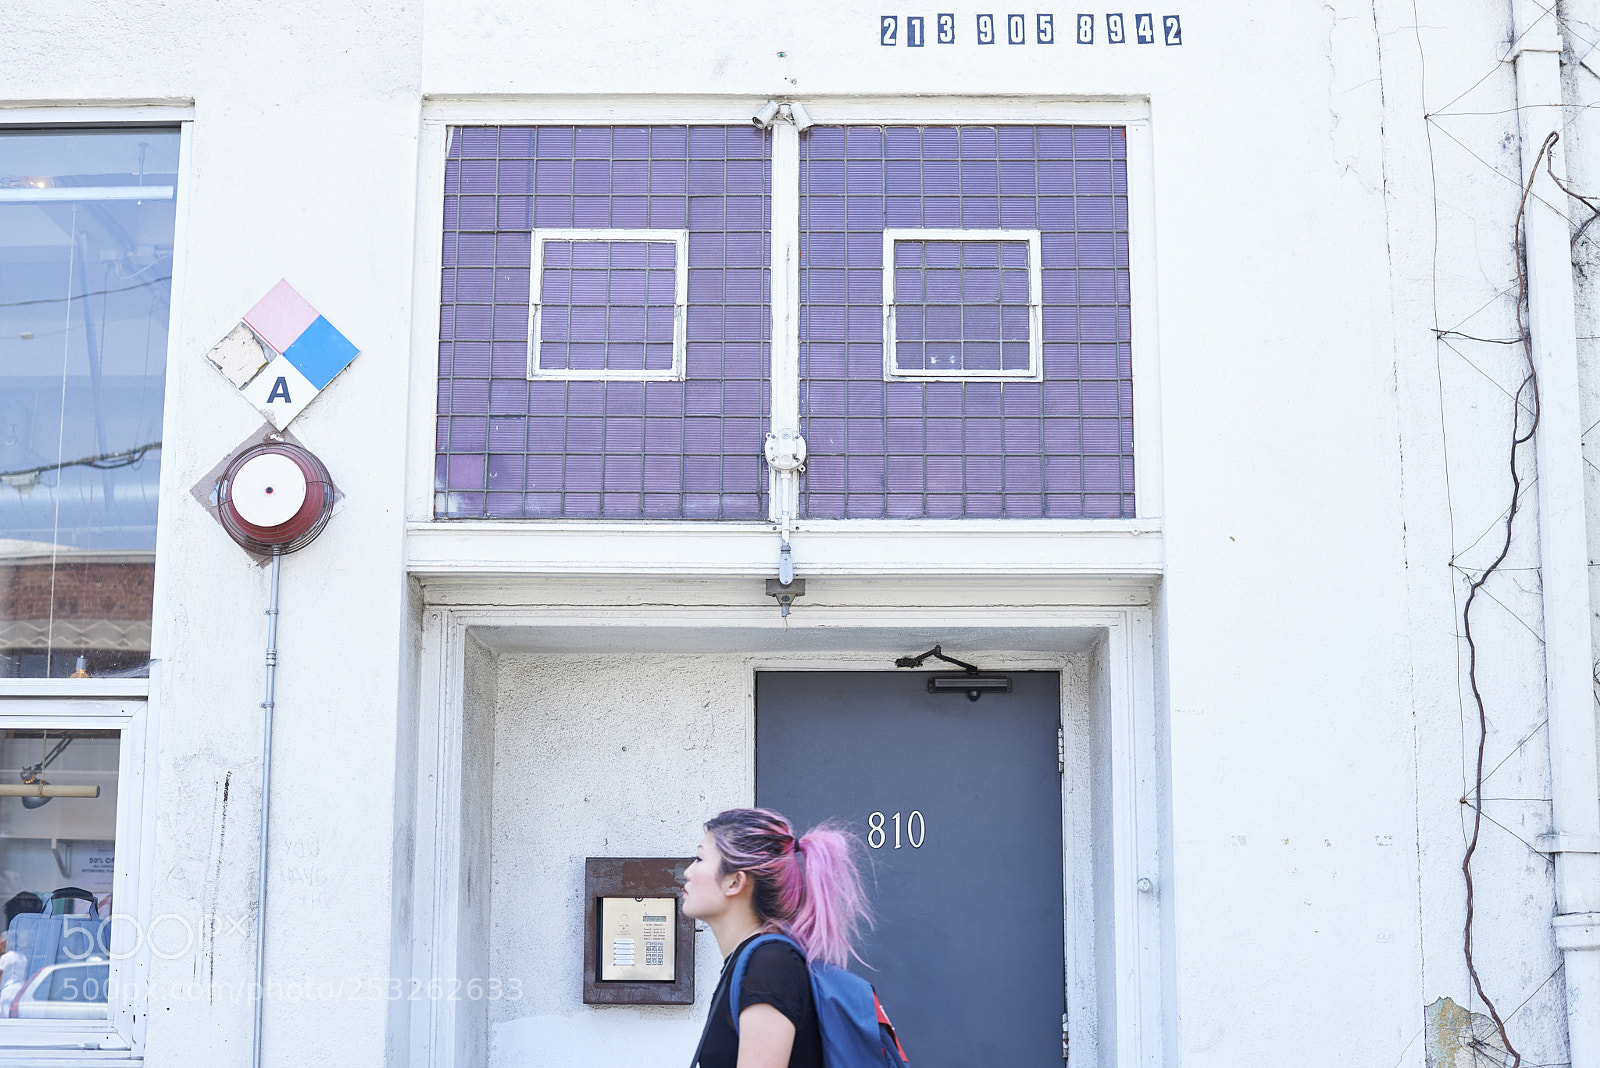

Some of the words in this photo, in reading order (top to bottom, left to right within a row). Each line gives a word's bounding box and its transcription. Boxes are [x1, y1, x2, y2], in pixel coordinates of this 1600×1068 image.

[883, 15, 954, 45] 213
[979, 15, 1052, 43] 905
[1079, 14, 1182, 45] 8942
[266, 376, 292, 404] A
[867, 810, 926, 850] 810
